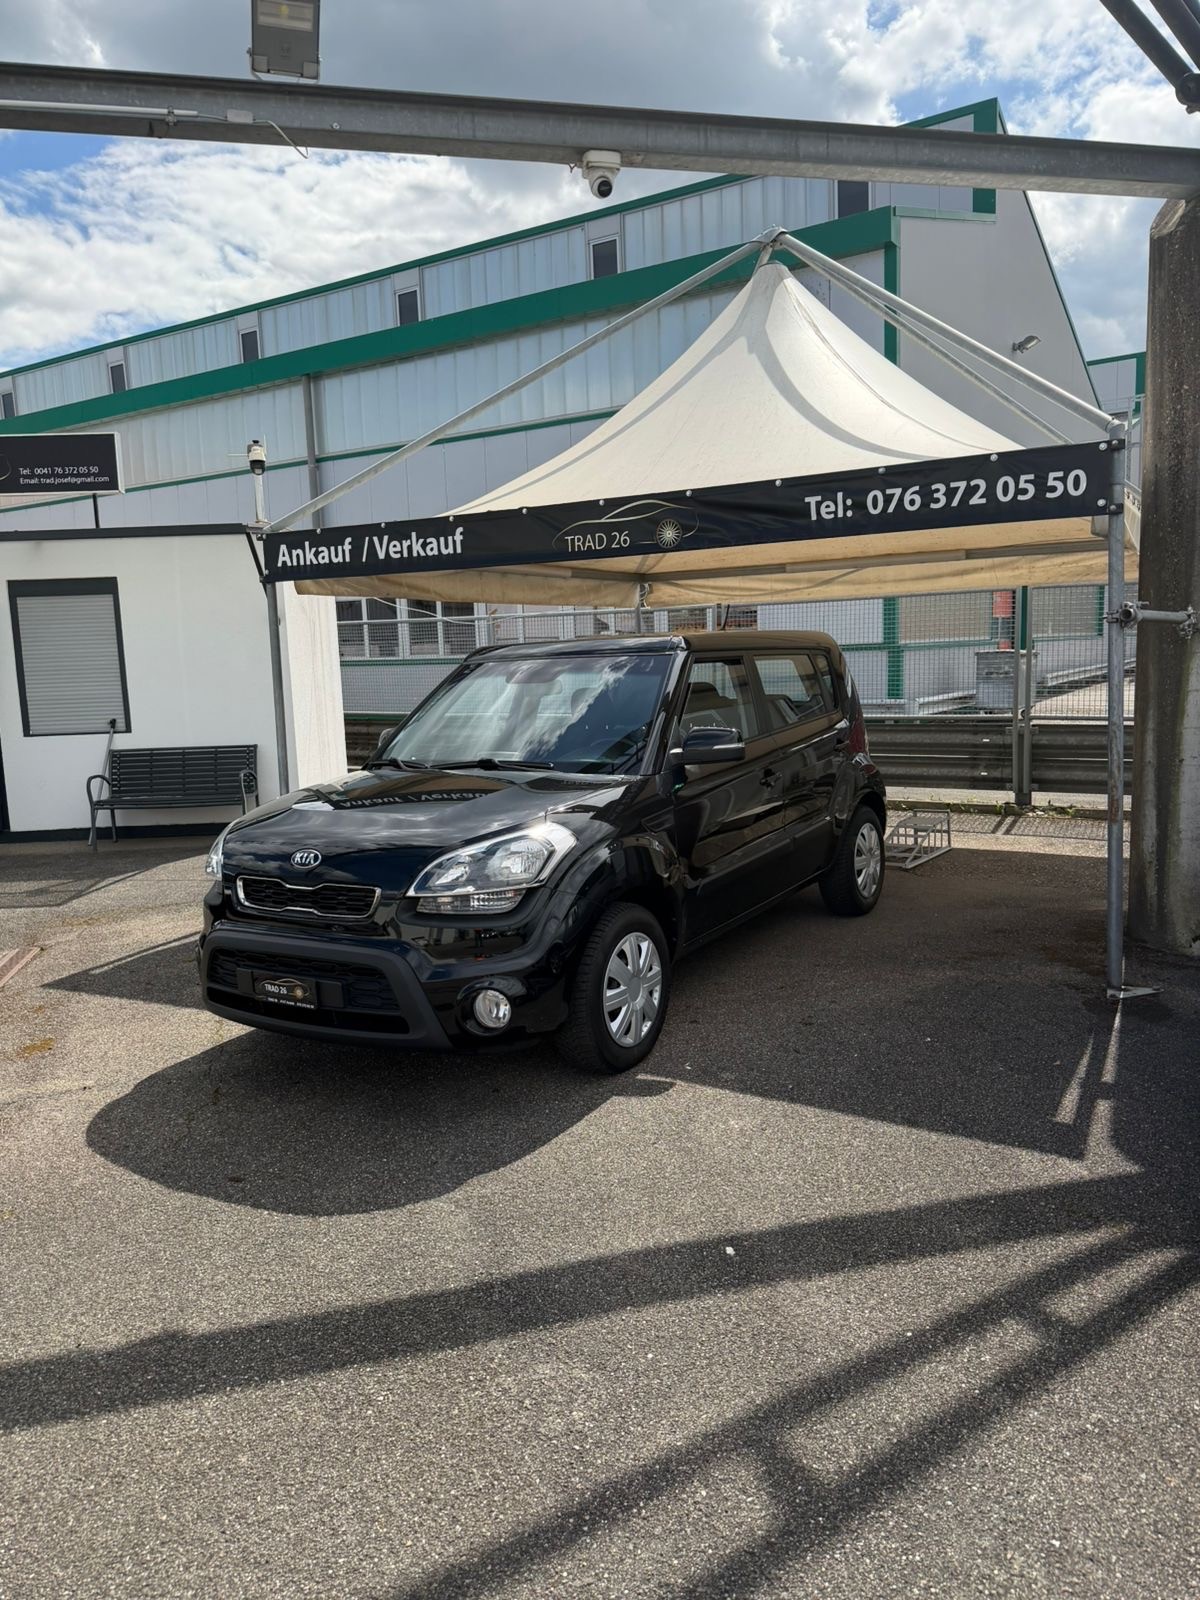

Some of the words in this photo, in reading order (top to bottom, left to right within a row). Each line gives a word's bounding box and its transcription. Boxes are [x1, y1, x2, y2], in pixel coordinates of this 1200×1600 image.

[19, 467, 32, 475] Tel:
[34, 467, 52, 475] 0041
[64, 466, 78, 474] 372
[40, 476, 110, 485] trad.josef@gmail.com
[804, 492, 853, 521] Tel:
[866, 485, 922, 515] 076
[929, 478, 987, 509] 372
[996, 474, 1036, 502] 05
[1045, 469, 1087, 498] 50
[564, 532, 607, 552] TRAD
[611, 531, 630, 548] 26
[277, 537, 352, 567] Ankauf
[294, 852, 315, 864] KIA
[264, 983, 279, 993] TRAD
[279, 986, 288, 995] 26
